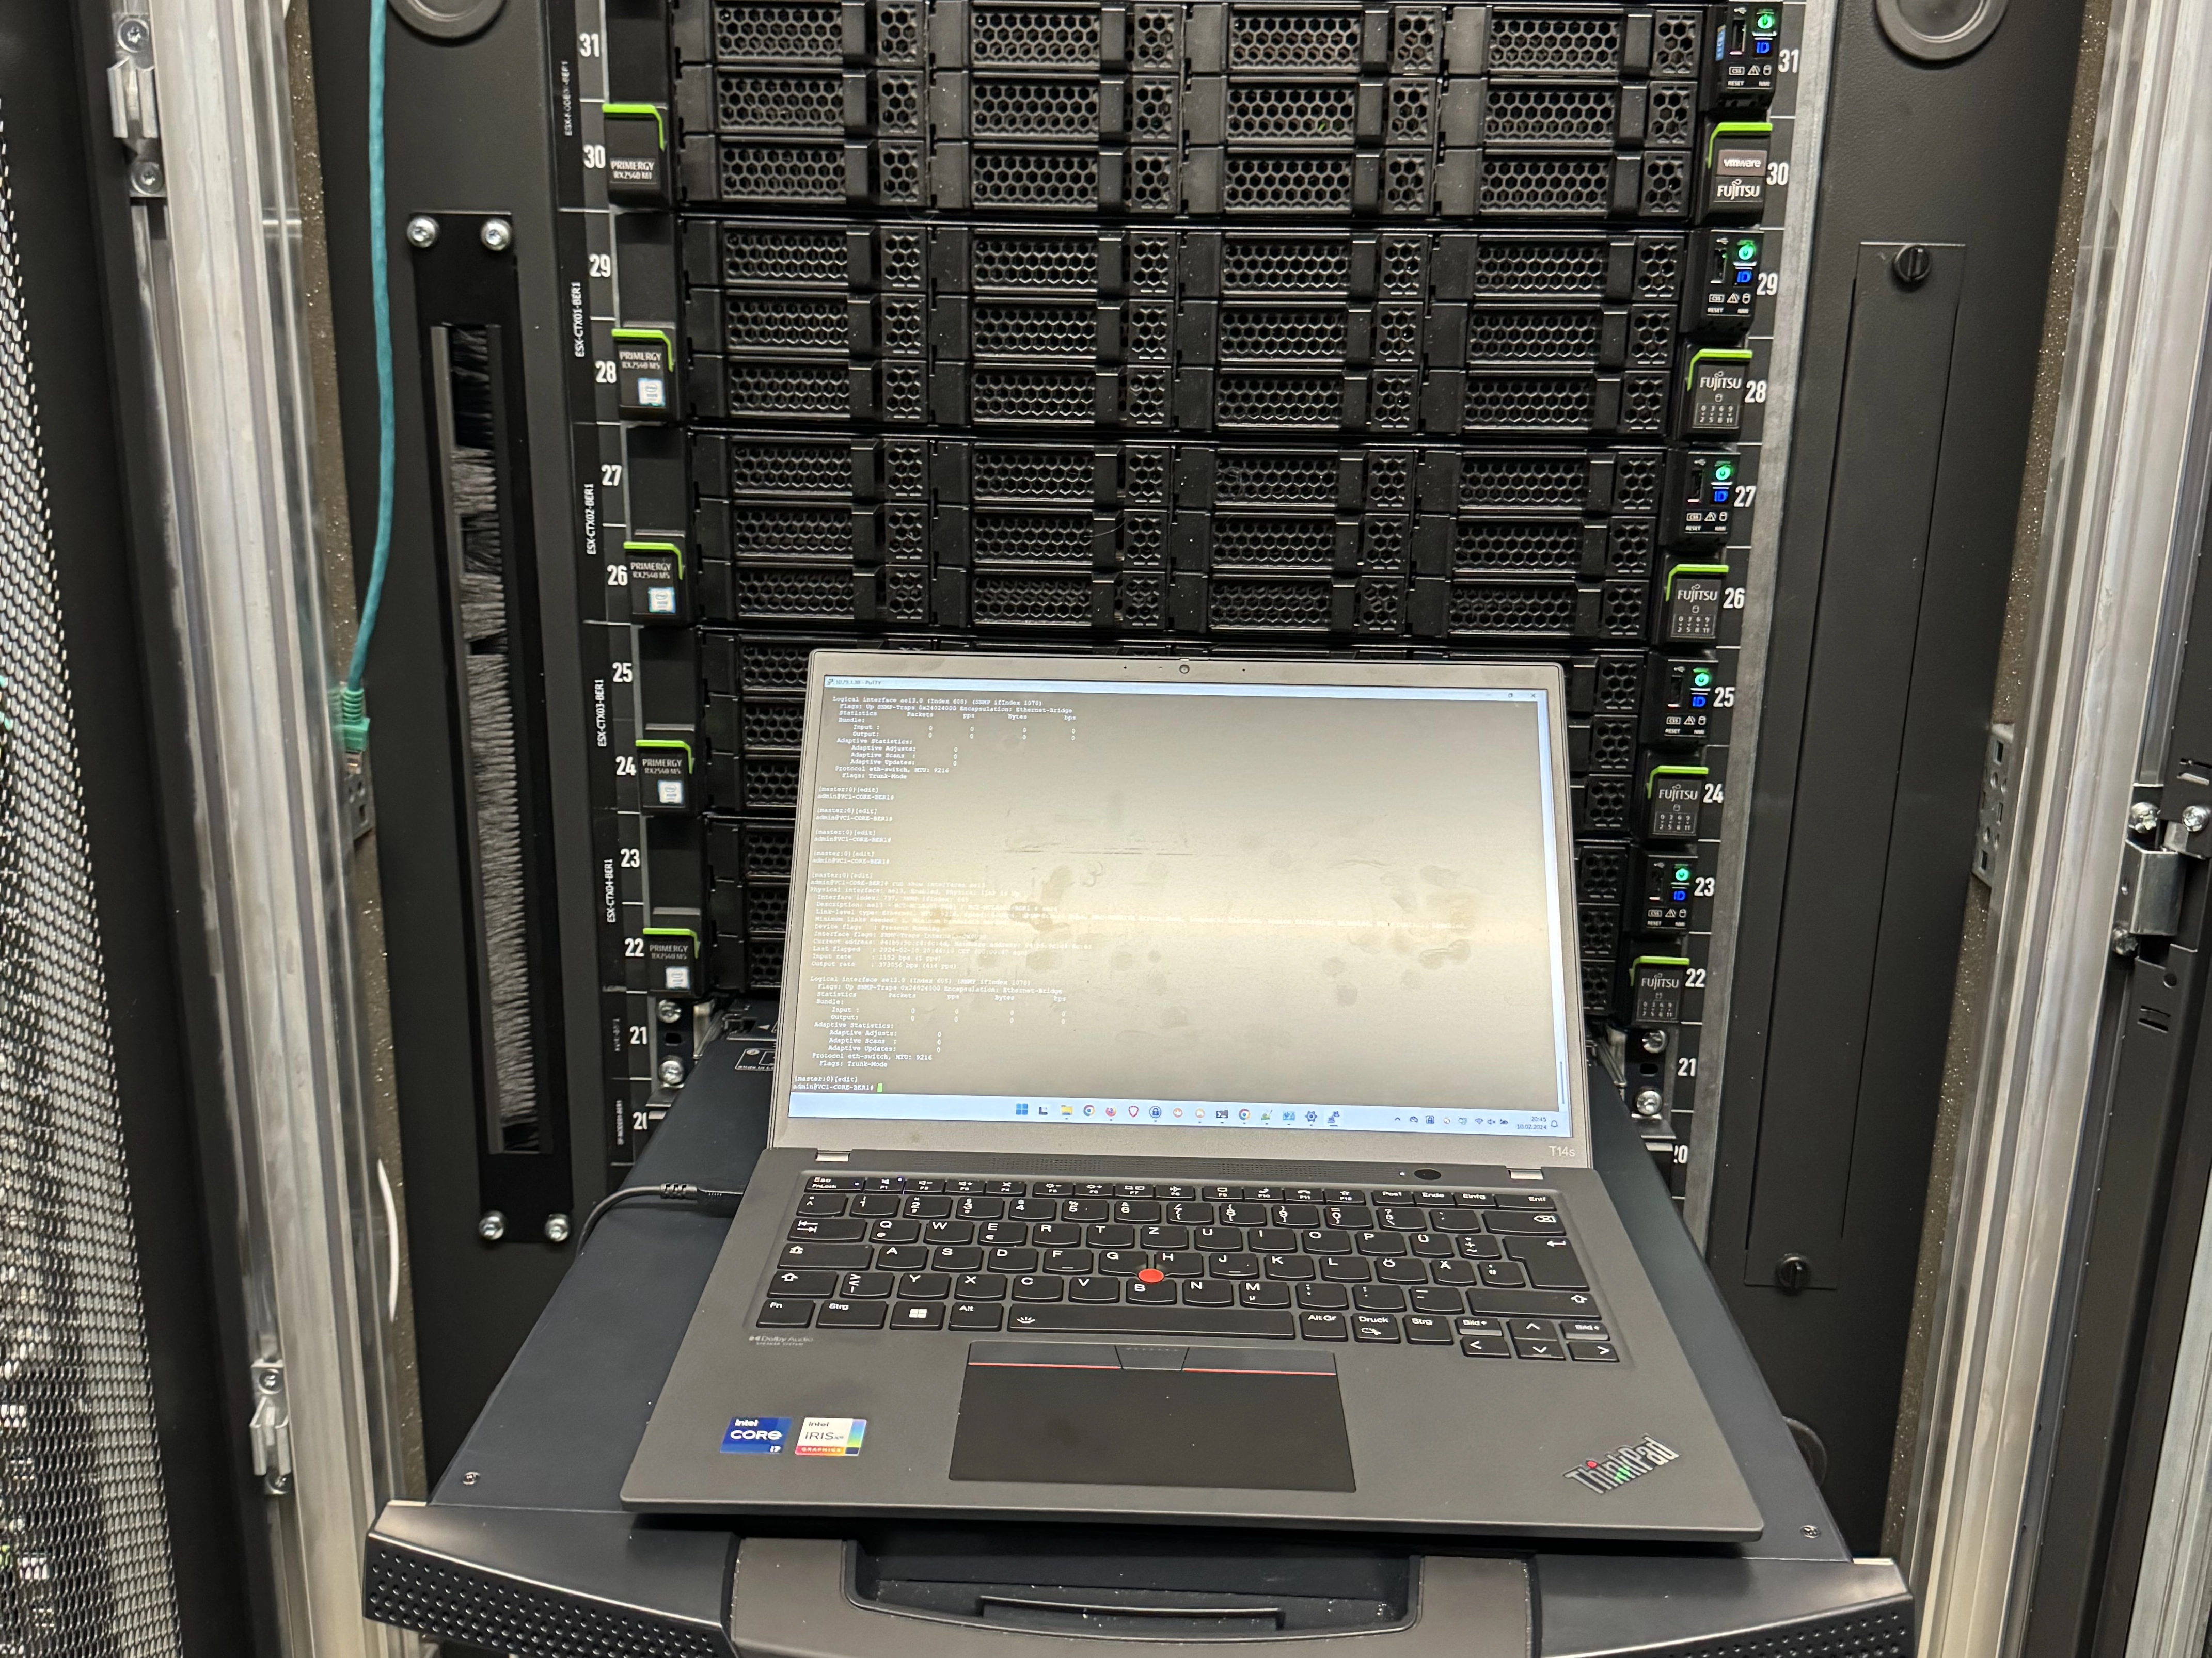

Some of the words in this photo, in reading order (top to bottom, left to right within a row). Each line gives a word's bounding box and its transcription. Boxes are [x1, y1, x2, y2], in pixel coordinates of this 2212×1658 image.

[579, 33, 600, 57] 31
[1756, 42, 1770, 54] ID
[1778, 49, 1799, 73] 31
[583, 145, 606, 168] 30
[610, 161, 654, 171] PRIMERGY
[1723, 158, 1761, 167] vmware
[1766, 162, 1789, 186] 30
[1717, 179, 1760, 200] FUJITSU
[589, 254, 611, 278] 29
[1736, 270, 1752, 283] ID
[1756, 272, 1778, 296] 29
[571, 282, 585, 357] ESX-CTX01-BER1
[620, 351, 661, 361] PRIMERGY
[595, 361, 617, 384] 28
[1700, 371, 1742, 391] FUJITSU
[1744, 380, 1767, 403] 28
[601, 465, 622, 486] 27
[1714, 490, 1728, 502] ID
[1733, 485, 1757, 507] 27
[584, 484, 596, 555] ESX-CTX02-BER1
[607, 565, 628, 586] 26
[630, 562, 671, 571] PRIMERGY
[1677, 584, 1718, 603] FUJITSU
[1723, 587, 1745, 609] 26
[612, 662, 633, 683] 25
[1692, 696, 1706, 707] ID
[1713, 687, 1735, 707] 25
[594, 679, 607, 747] ESX-CTX03-BER1
[616, 756, 637, 776] 24
[642, 759, 682, 767] PRIMERGY
[1658, 784, 1698, 801] FUJITSU
[1703, 783, 1724, 803] 24
[621, 848, 640, 868] 23
[604, 859, 615, 923] ESX-CTX04-BER1
[1673, 890, 1686, 901] ID
[1694, 876, 1715, 897] 23
[625, 938, 645, 957] 22
[1641, 973, 1679, 990] FUJITSU
[1685, 968, 1706, 988] 22
[630, 1026, 647, 1044] 21
[1678, 1058, 1696, 1076] 21
[1549, 1146, 1576, 1157] T14s
[1418, 1234, 1429, 1243] Ü
[1383, 1258, 1396, 1268] Ö
[1440, 1260, 1451, 1270] Ä
[909, 1274, 921, 1283] Y
[1021, 1277, 1033, 1285] C
[1078, 1278, 1089, 1286] V
[1562, 1434, 1680, 1494] ThinkPad
